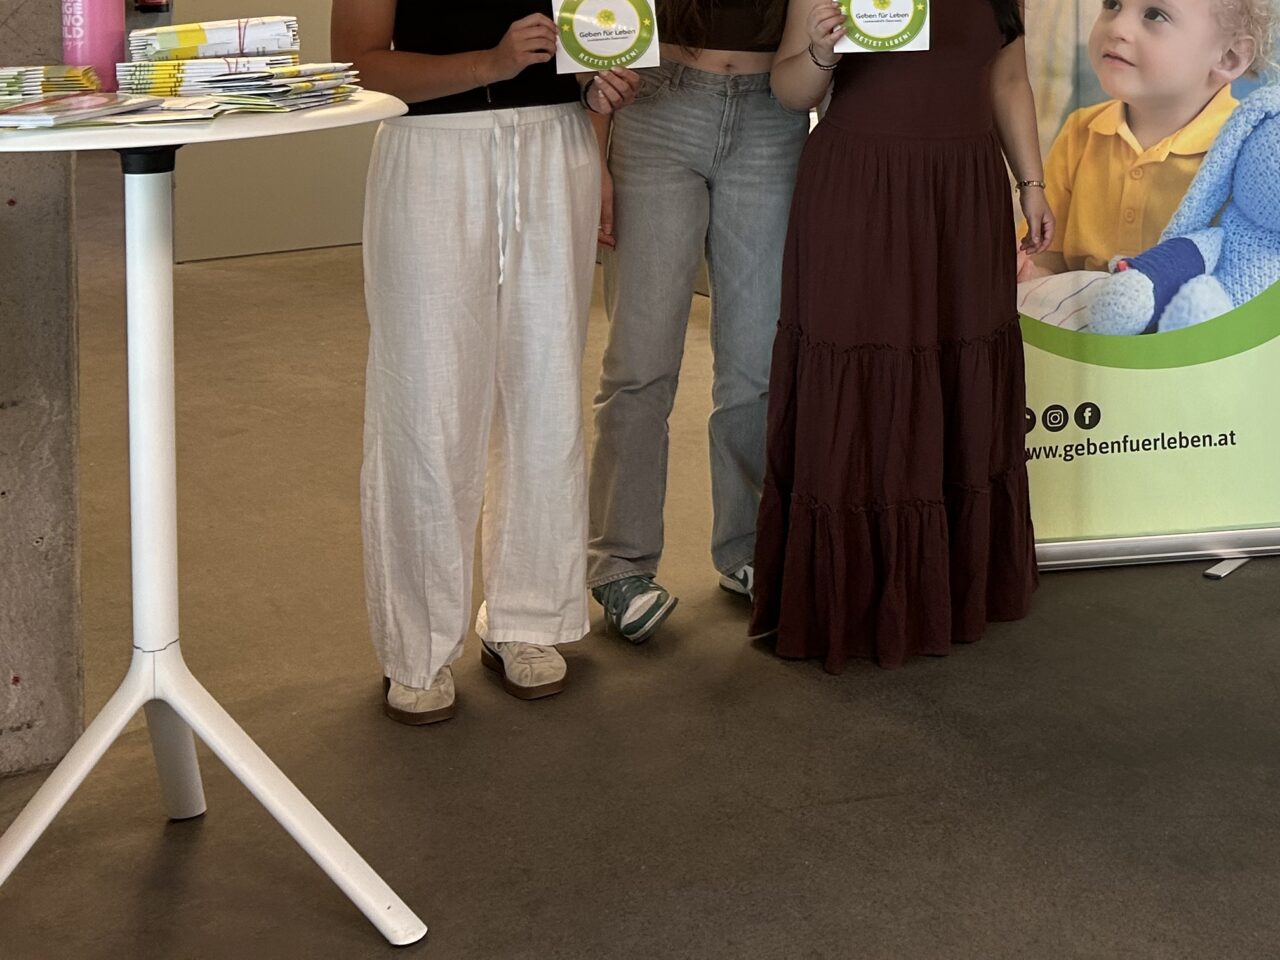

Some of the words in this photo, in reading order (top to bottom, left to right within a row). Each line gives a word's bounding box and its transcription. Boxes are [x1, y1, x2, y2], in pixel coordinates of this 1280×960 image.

[854, 32, 882, 47] RETTET
[885, 31, 912, 47] LEBEN!
[578, 52, 609, 66] RETTET
[611, 49, 640, 66] LEBEN!
